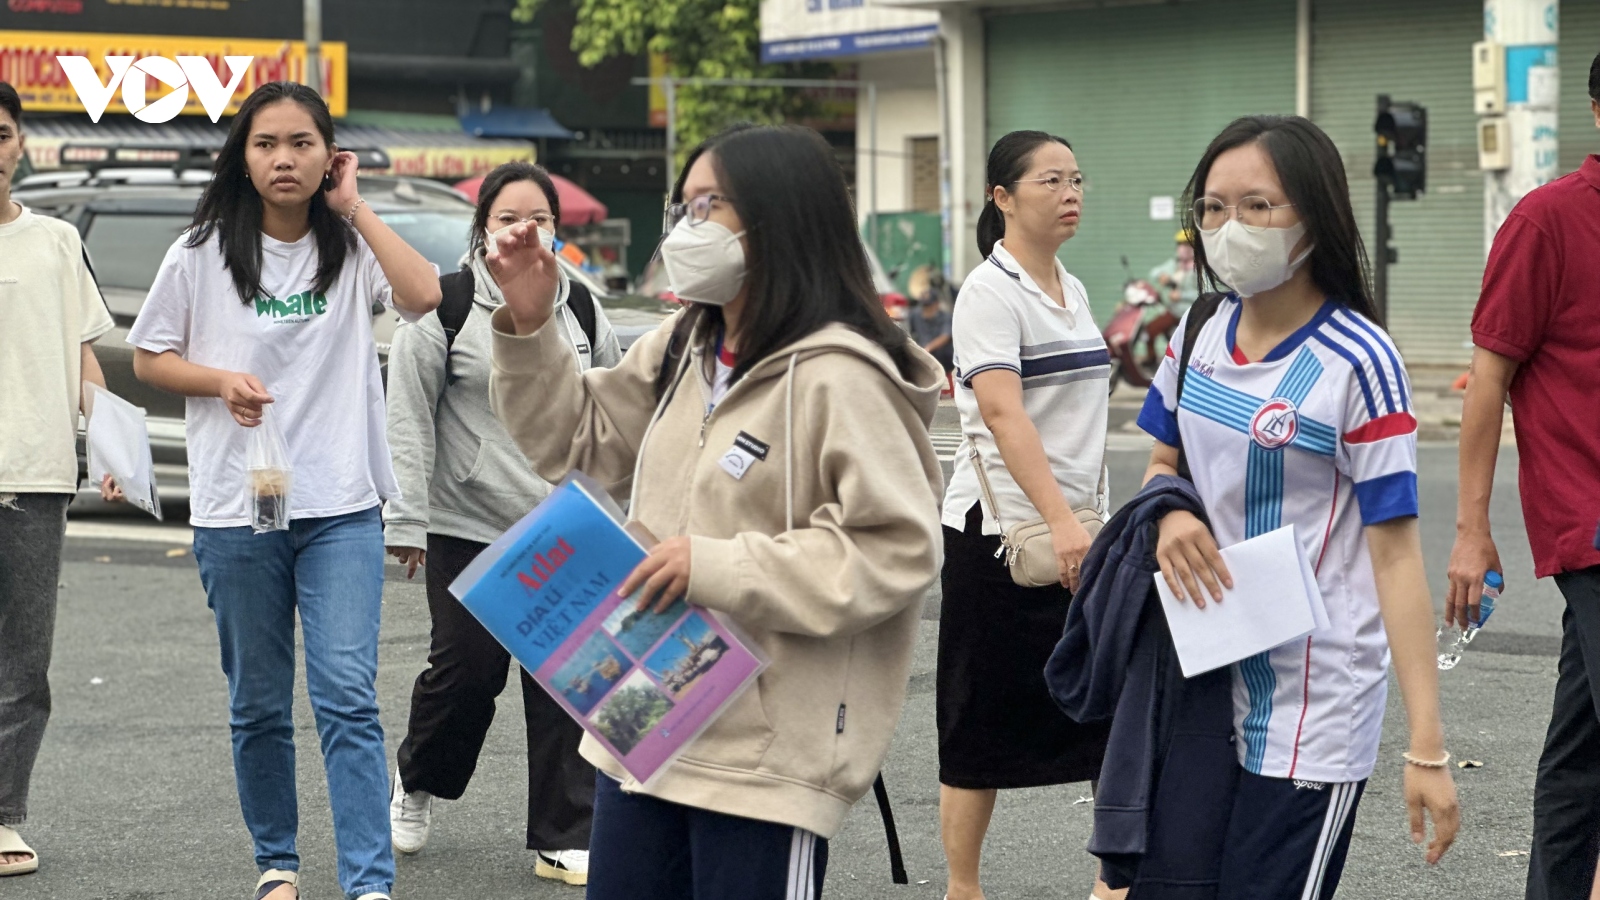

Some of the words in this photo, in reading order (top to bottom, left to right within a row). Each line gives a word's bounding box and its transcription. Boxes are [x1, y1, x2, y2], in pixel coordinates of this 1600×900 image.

[517, 534, 576, 598] Atlat
[531, 607, 574, 651] VIỆT
[570, 570, 611, 615] NAM
